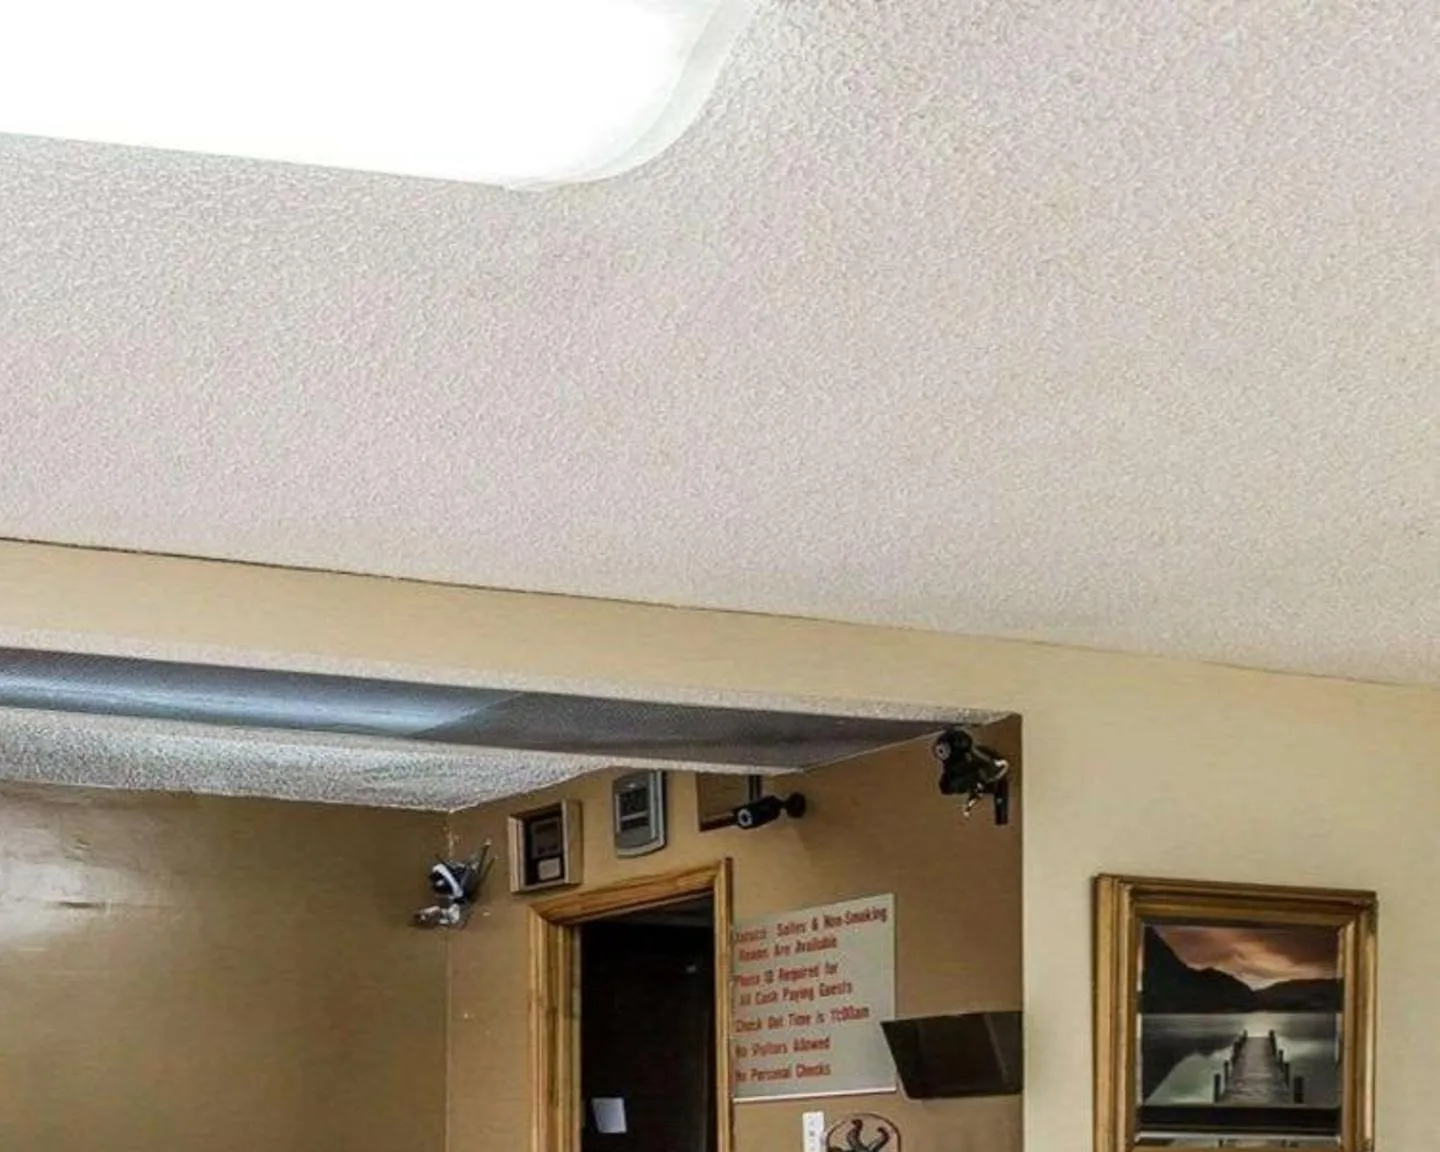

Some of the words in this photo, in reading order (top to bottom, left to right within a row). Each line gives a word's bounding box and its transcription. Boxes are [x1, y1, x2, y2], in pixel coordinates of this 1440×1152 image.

[811, 917, 819, 931] &
[823, 906, 888, 928] Non-Smoking
[739, 947, 769, 961] Rooms
[774, 943, 791, 957] Are
[795, 936, 838, 953] Available
[779, 965, 819, 982] Required
[825, 961, 839, 974] for
[755, 990, 779, 1005] Cash
[782, 985, 814, 1003] Paying
[819, 981, 852, 997] Guests
[736, 1019, 762, 1033] Check
[768, 1015, 783, 1029] Out
[788, 1012, 811, 1026] Time
[816, 1010, 825, 1024] is
[735, 1045, 748, 1058] No
[752, 1042, 788, 1057] Visitors
[793, 1037, 831, 1052] Allowed
[735, 1069, 747, 1082] No
[751, 1067, 791, 1081] Personal
[795, 1063, 831, 1078] Checks
